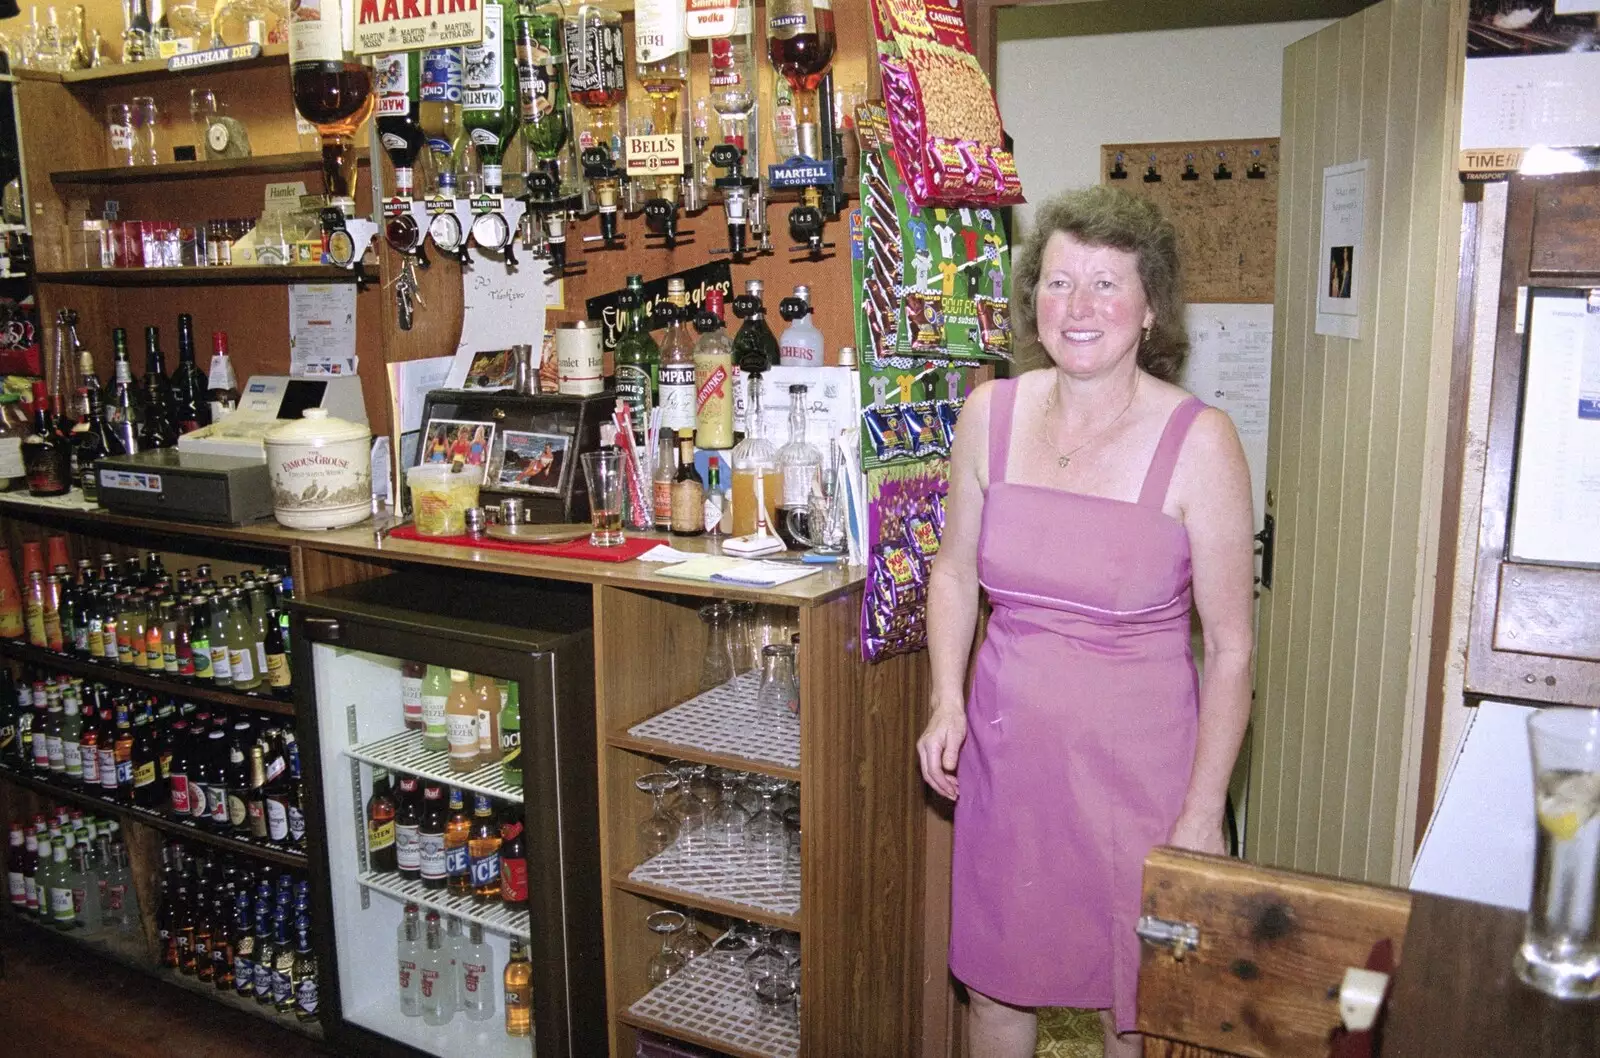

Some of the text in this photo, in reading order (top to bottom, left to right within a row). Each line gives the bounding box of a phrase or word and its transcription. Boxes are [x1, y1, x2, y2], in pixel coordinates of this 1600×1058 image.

[697, 12, 725, 24] vodka
[929, 11, 964, 27] CASHEWS
[400, 27, 426, 36] MARTINI
[445, 22, 472, 31] MARTINI
[360, 31, 385, 41] MARTINI
[172, 44, 254, 68] BABYCHAM DRY
[631, 137, 676, 153] BELL'S
[649, 157, 658, 168] 8
[774, 167, 827, 180] MARTELL
[1466, 172, 1506, 180] TRANSPORT
[784, 177, 817, 185] COGNAC
[270, 186, 296, 198] Hamlet
[384, 203, 410, 211] MARTINI
[427, 200, 453, 209] MARTINI
[472, 199, 500, 208] MARTINI
[281, 454, 350, 473] FAMOUS GROUSE
